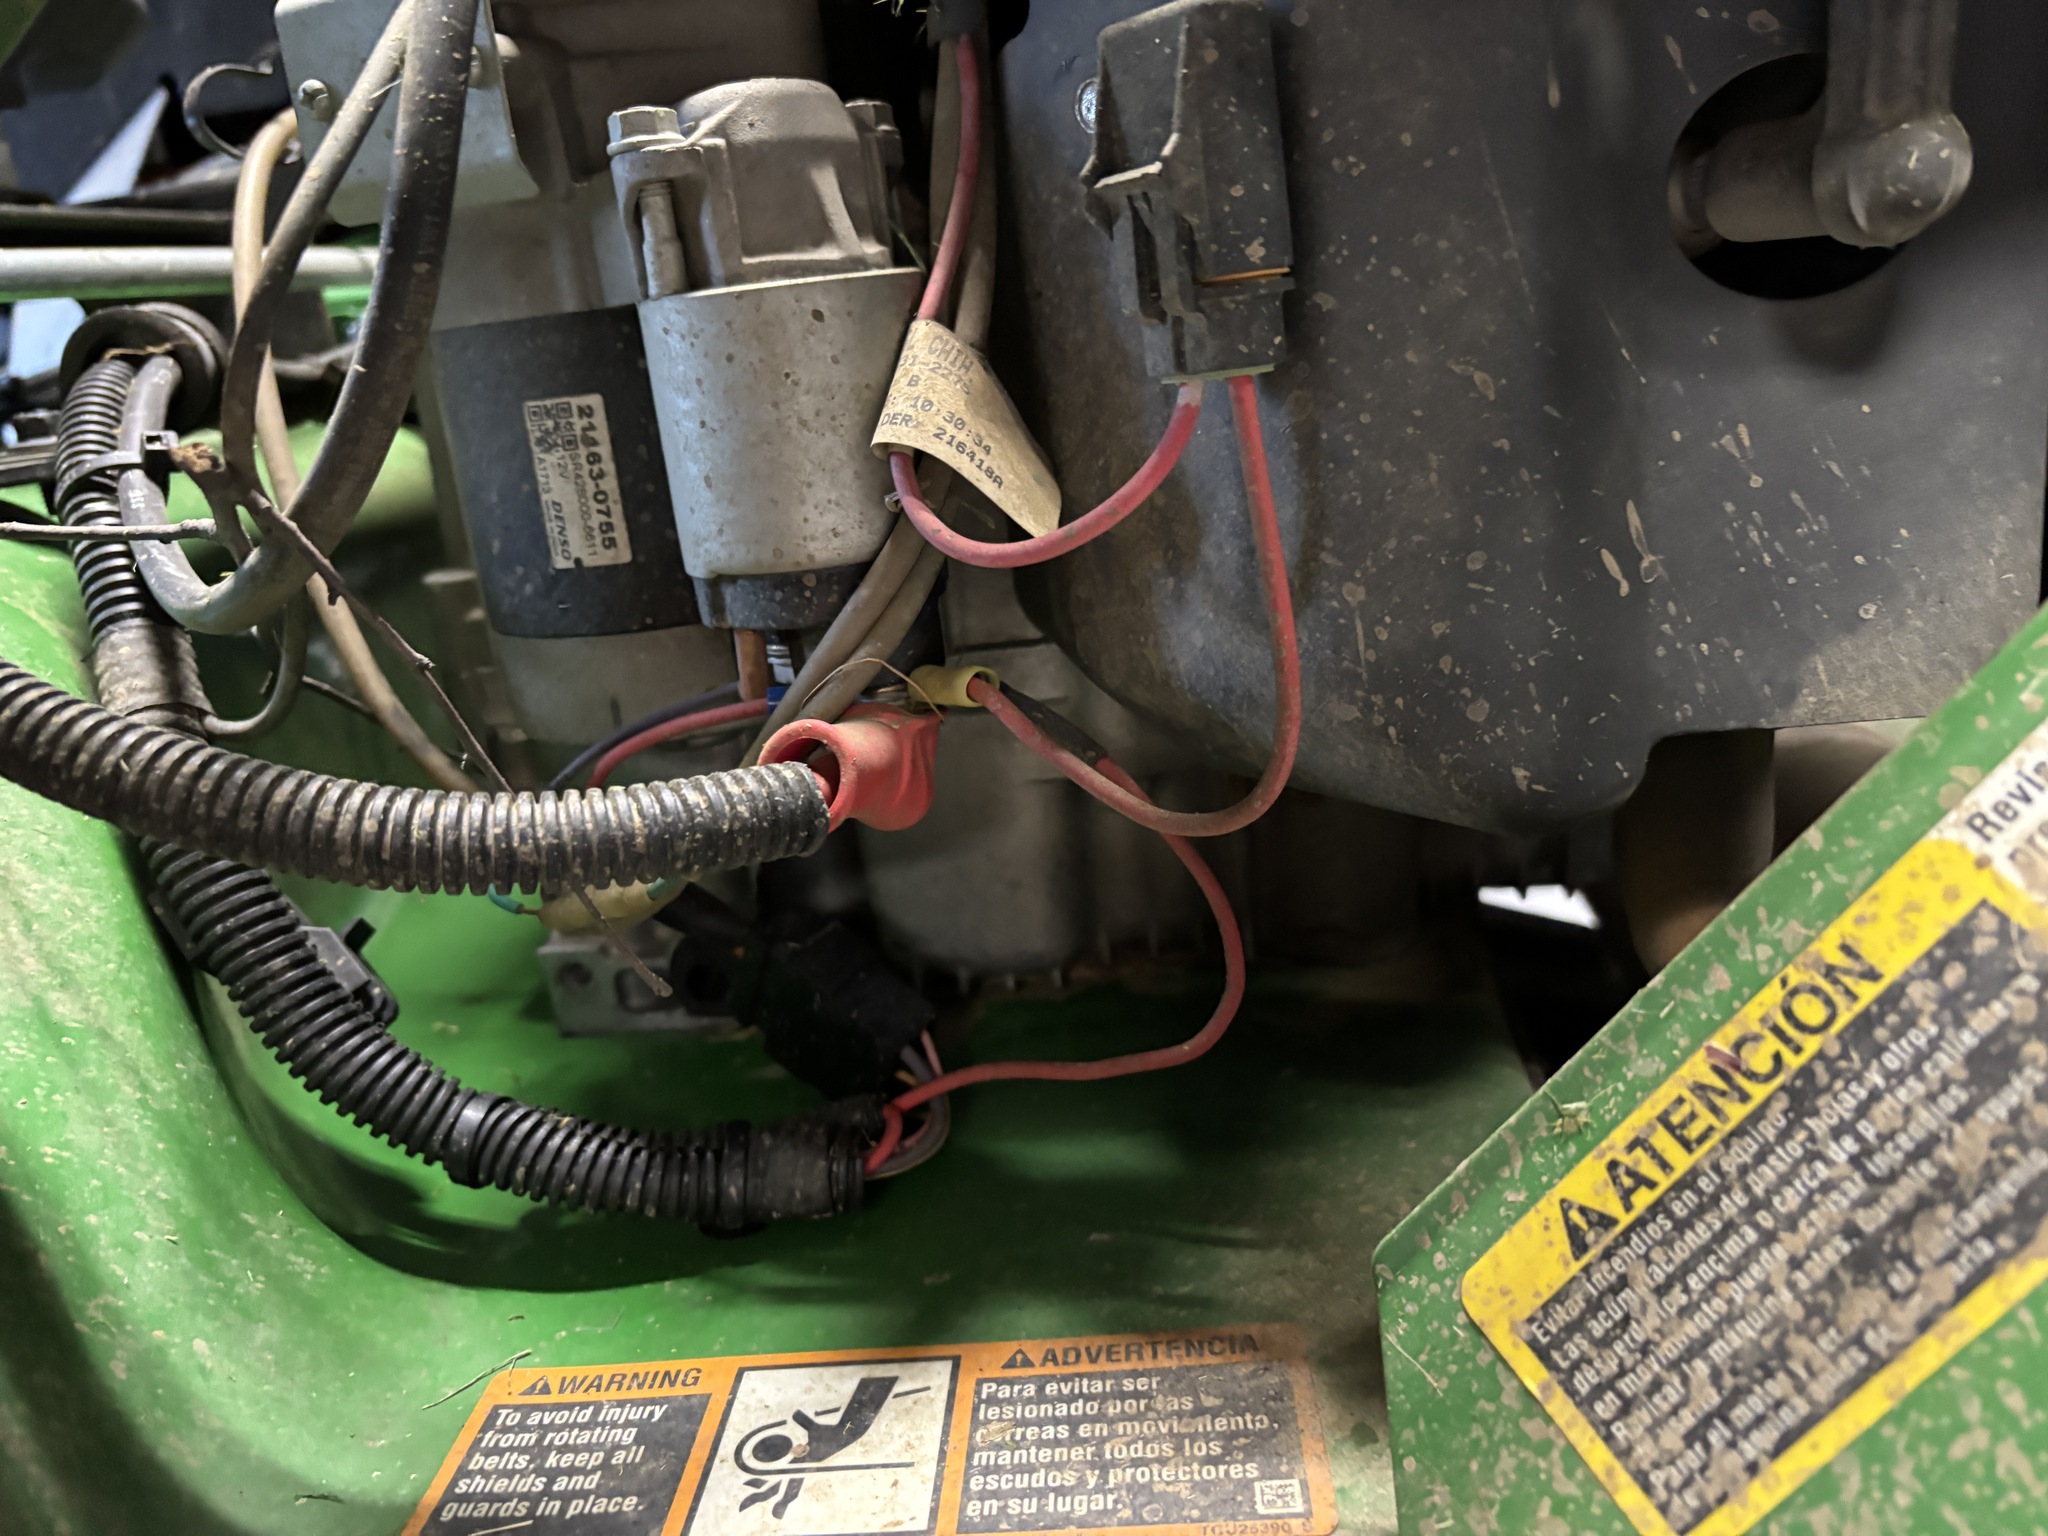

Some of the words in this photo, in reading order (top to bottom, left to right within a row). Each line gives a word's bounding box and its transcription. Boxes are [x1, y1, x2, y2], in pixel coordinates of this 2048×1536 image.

[906, 374, 921, 387] B
[909, 394, 993, 456] 10:30:34
[932, 426, 1005, 490] 216418A
[551, 499, 572, 562] DENSO
[1601, 942, 1884, 1212] ATENCIÓN
[1681, 1219, 1762, 1295] encima
[1753, 1208, 1775, 1230] o
[1822, 1127, 1862, 1166] de
[1713, 1182, 1751, 1219] de
[1579, 1208, 1675, 1297] incendios
[1667, 1186, 1701, 1219] en
[1693, 1165, 1722, 1195] el
[1038, 1334, 1259, 1366] ADVERTENCIA
[557, 1367, 703, 1394] WARNING
[980, 1380, 1035, 1399] Para
[1044, 1376, 1114, 1395] evitar
[1122, 1374, 1161, 1392] ser
[494, 1408, 521, 1427] To
[526, 1405, 597, 1425] avoid
[596, 1403, 668, 1424] injury
[978, 1398, 1099, 1421] lesionado
[1107, 1396, 1148, 1416] por
[1591, 1387, 1624, 1419] en
[479, 1429, 536, 1448] from
[542, 1424, 637, 1447] rotating
[974, 1422, 1070, 1443] crreas
[1078, 1421, 1108, 1438] en
[467, 1451, 535, 1471] belts,
[544, 1450, 604, 1471] keep
[611, 1445, 645, 1464] all
[971, 1445, 1096, 1467] mantener
[1103, 1439, 1174, 1459] todos
[1183, 1437, 1223, 1456] los
[453, 1473, 546, 1495] shields
[552, 1471, 602, 1491] and
[968, 1469, 1077, 1492] escudos
[1085, 1472, 1100, 1489] y
[1107, 1460, 1259, 1486] protectores
[439, 1497, 530, 1520] guards
[534, 1496, 563, 1516] in
[564, 1494, 645, 1519] place.
[966, 1497, 998, 1517] en
[1006, 1494, 1037, 1514] su
[1047, 1489, 1123, 1515] lugar.
